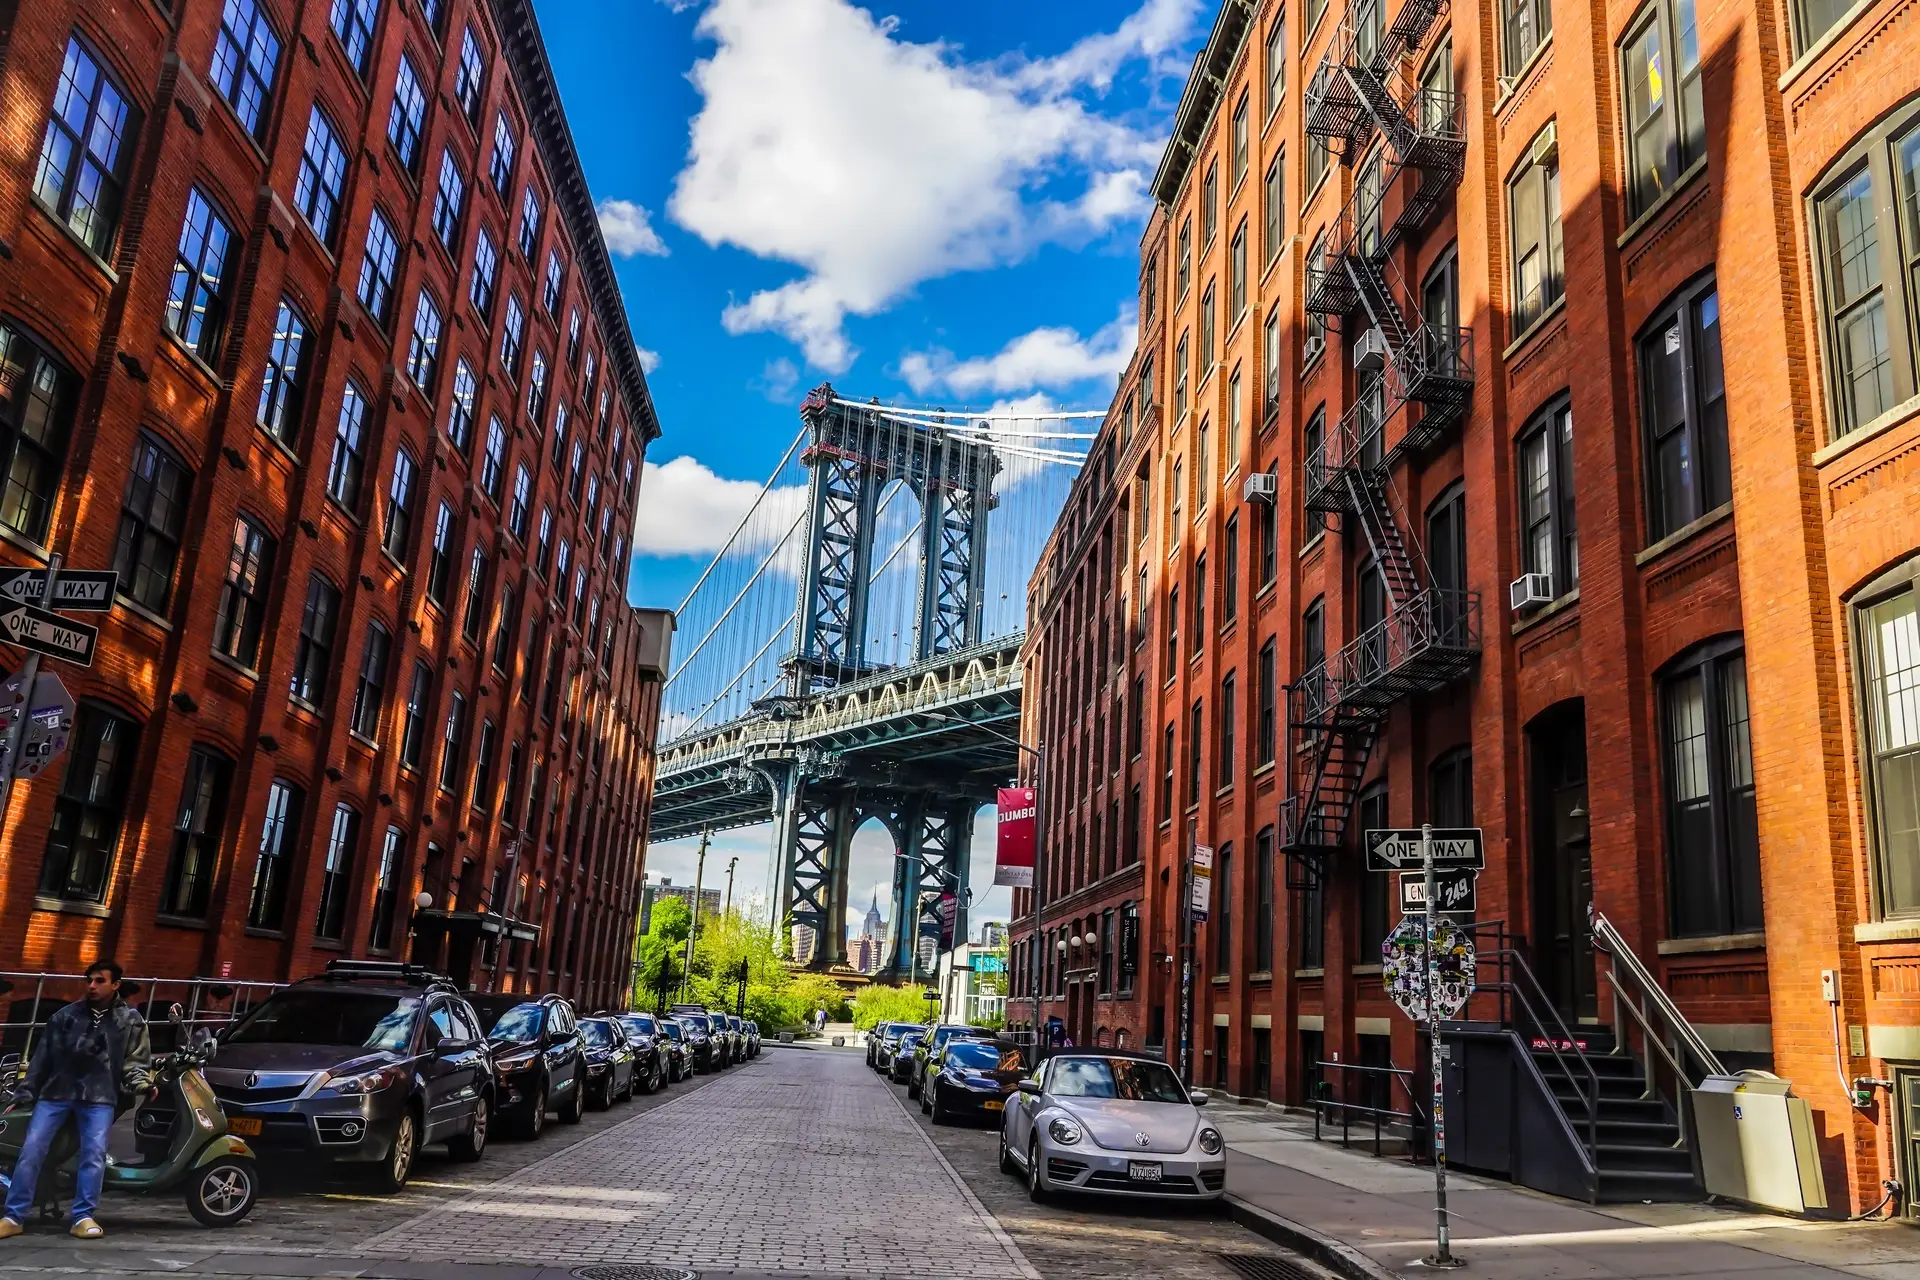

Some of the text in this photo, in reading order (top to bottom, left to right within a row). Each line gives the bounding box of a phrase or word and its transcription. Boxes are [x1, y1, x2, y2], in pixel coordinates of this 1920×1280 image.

[13, 580, 99, 598] ONE WAY
[10, 614, 83, 650] ONE WAY
[998, 807, 1036, 824] DUMBO
[1385, 841, 1467, 857] ONE WAY
